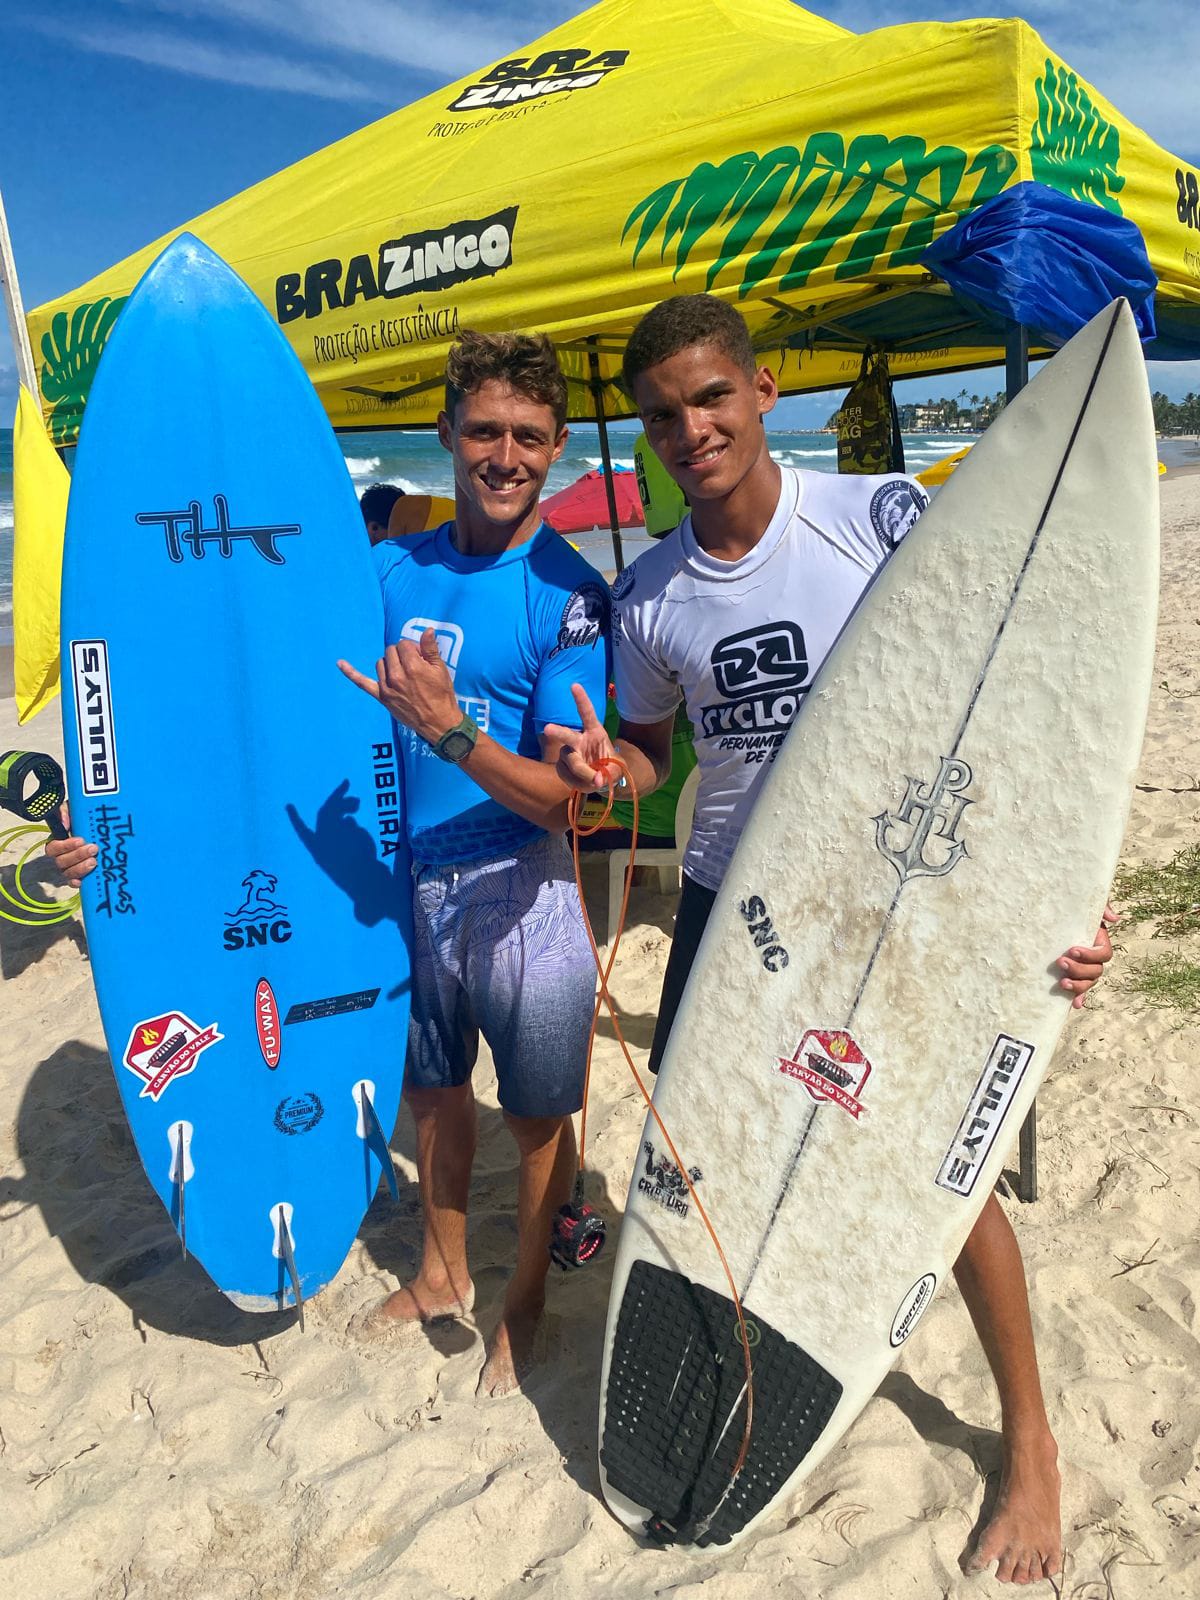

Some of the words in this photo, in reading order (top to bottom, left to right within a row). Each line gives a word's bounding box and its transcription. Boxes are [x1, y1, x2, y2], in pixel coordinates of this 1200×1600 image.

[454, 72, 606, 108] ZINGO
[480, 49, 630, 82] BRA
[1175, 168, 1200, 232] BR
[275, 224, 510, 324] BRAZINGO
[314, 322, 369, 364] PROTEÇÃO
[371, 330, 379, 351] E
[380, 303, 460, 349] RESISTÊNCIA
[81, 646, 109, 787] BULLY'S
[719, 734, 785, 750] PERNAMB
[745, 750, 767, 764] DE
[372, 742, 402, 858] RIBEIRA
[223, 920, 292, 950] SNC
[740, 895, 790, 972] SNC
[189, 1033, 210, 1051] VALE
[946, 1045, 1022, 1187] BULLY'S
